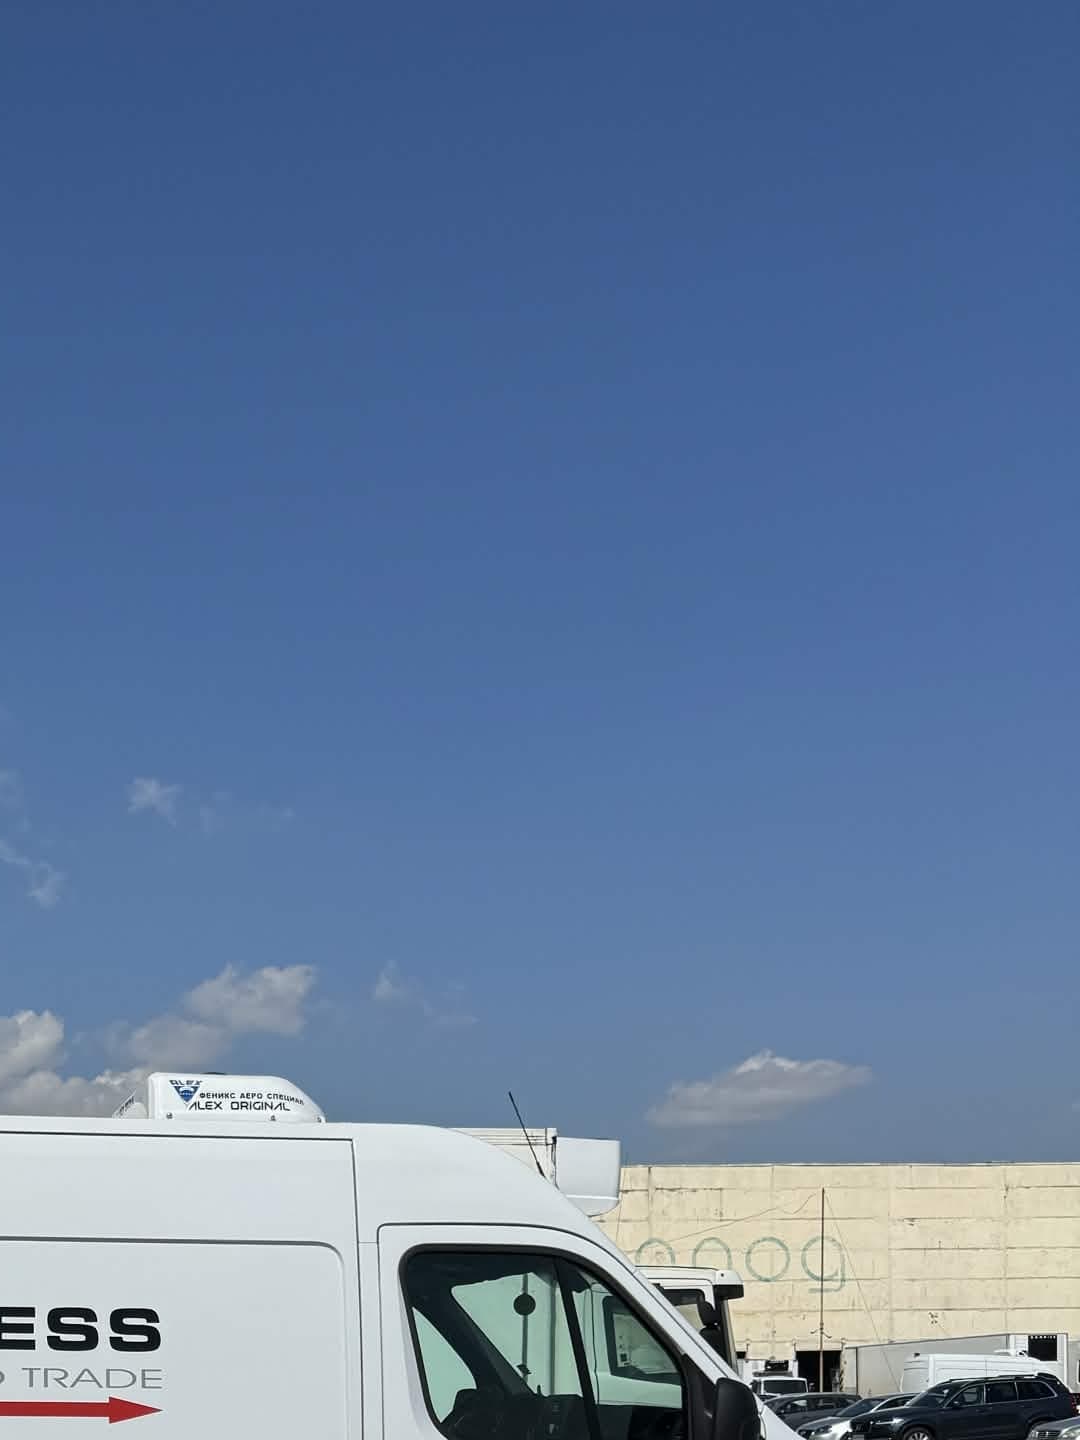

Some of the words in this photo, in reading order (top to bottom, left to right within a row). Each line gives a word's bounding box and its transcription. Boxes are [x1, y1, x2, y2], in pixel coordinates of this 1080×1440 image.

[199, 1092, 236, 1100] ФЕНИКС
[240, 1092, 263, 1100] АЕРО
[188, 1100, 223, 1111] ALEX
[230, 1101, 291, 1111] ORIGINAL
[22, 1367, 163, 1390] TRADE
